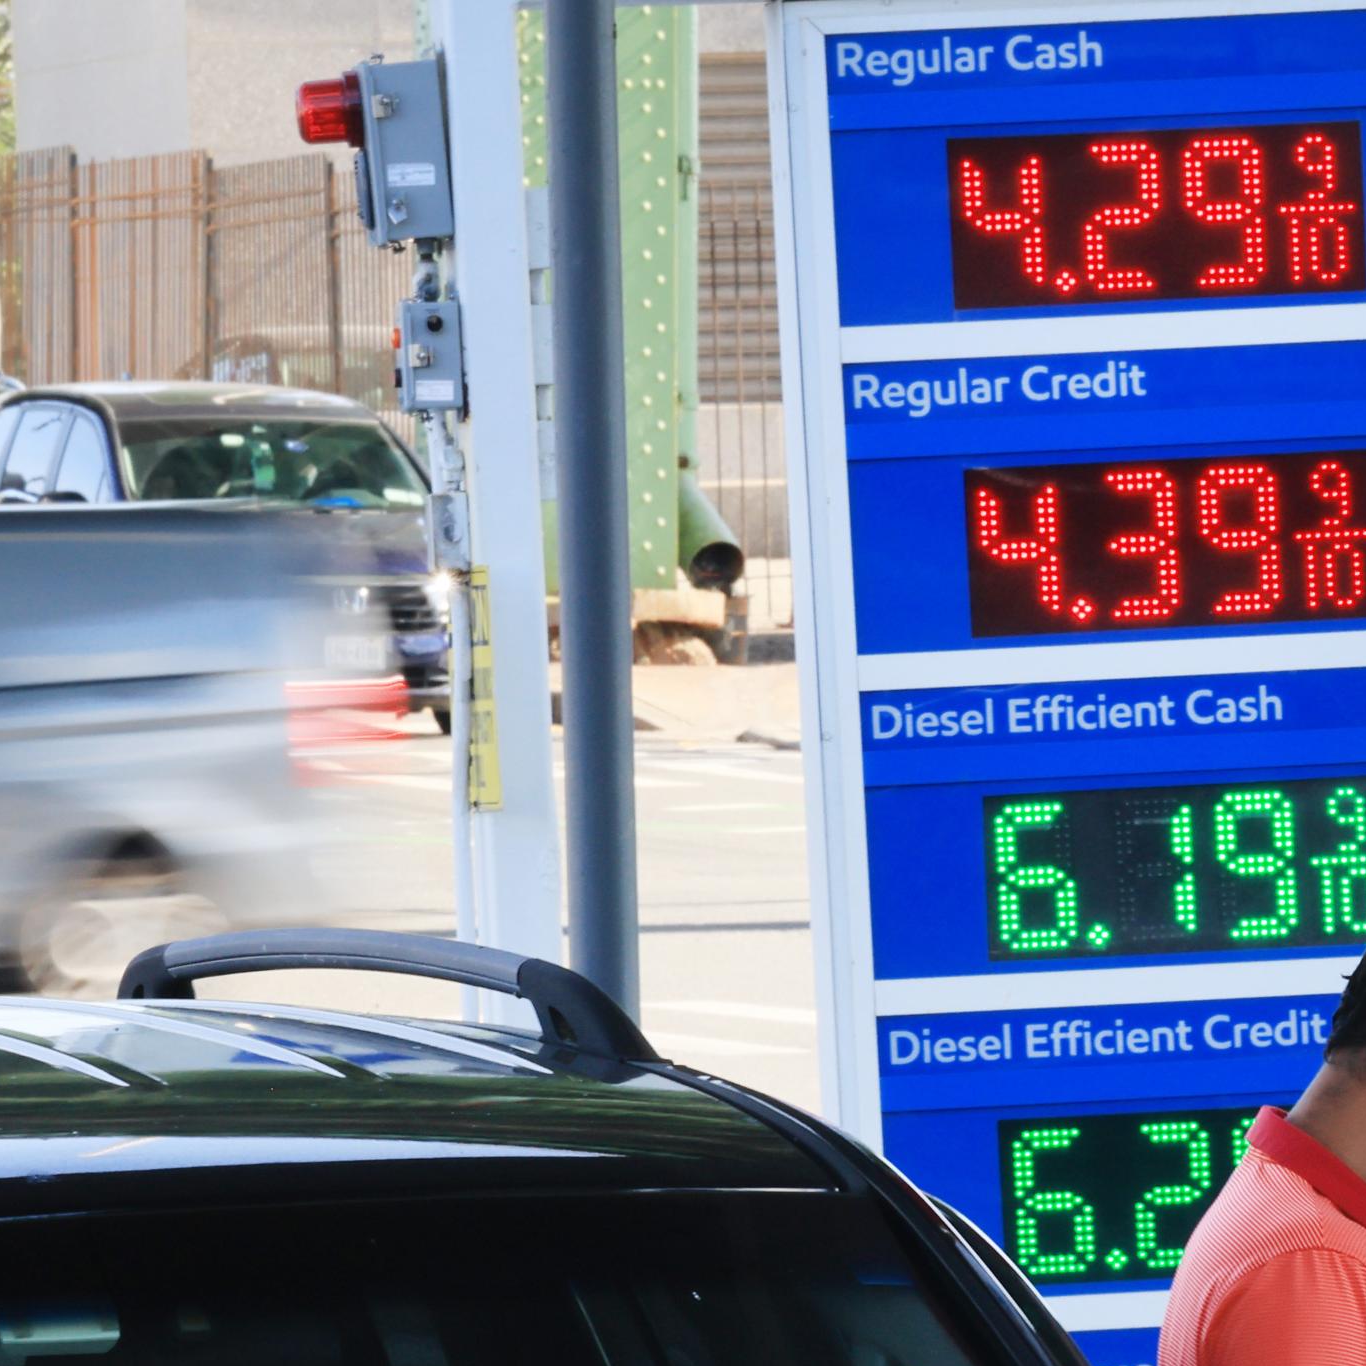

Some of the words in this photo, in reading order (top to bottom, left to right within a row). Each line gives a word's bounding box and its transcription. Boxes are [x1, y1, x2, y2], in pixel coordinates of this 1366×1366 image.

[837, 38, 993, 86] Regular
[1005, 31, 1103, 73] Cash
[959, 135, 1268, 295] 4.29
[852, 368, 1010, 417] Regular
[1020, 361, 1148, 404] Credit
[975, 463, 1283, 623] 4.39
[871, 695, 995, 741] Diesel
[1006, 687, 1176, 734] Efficient
[1185, 683, 1284, 726] Cash
[992, 788, 1300, 952] 6.19
[889, 1022, 1013, 1068] Diesel
[1024, 1014, 1193, 1060] Efficient
[1202, 1006, 1327, 1050] Credit
[1010, 1117, 1256, 1277] 6.2
